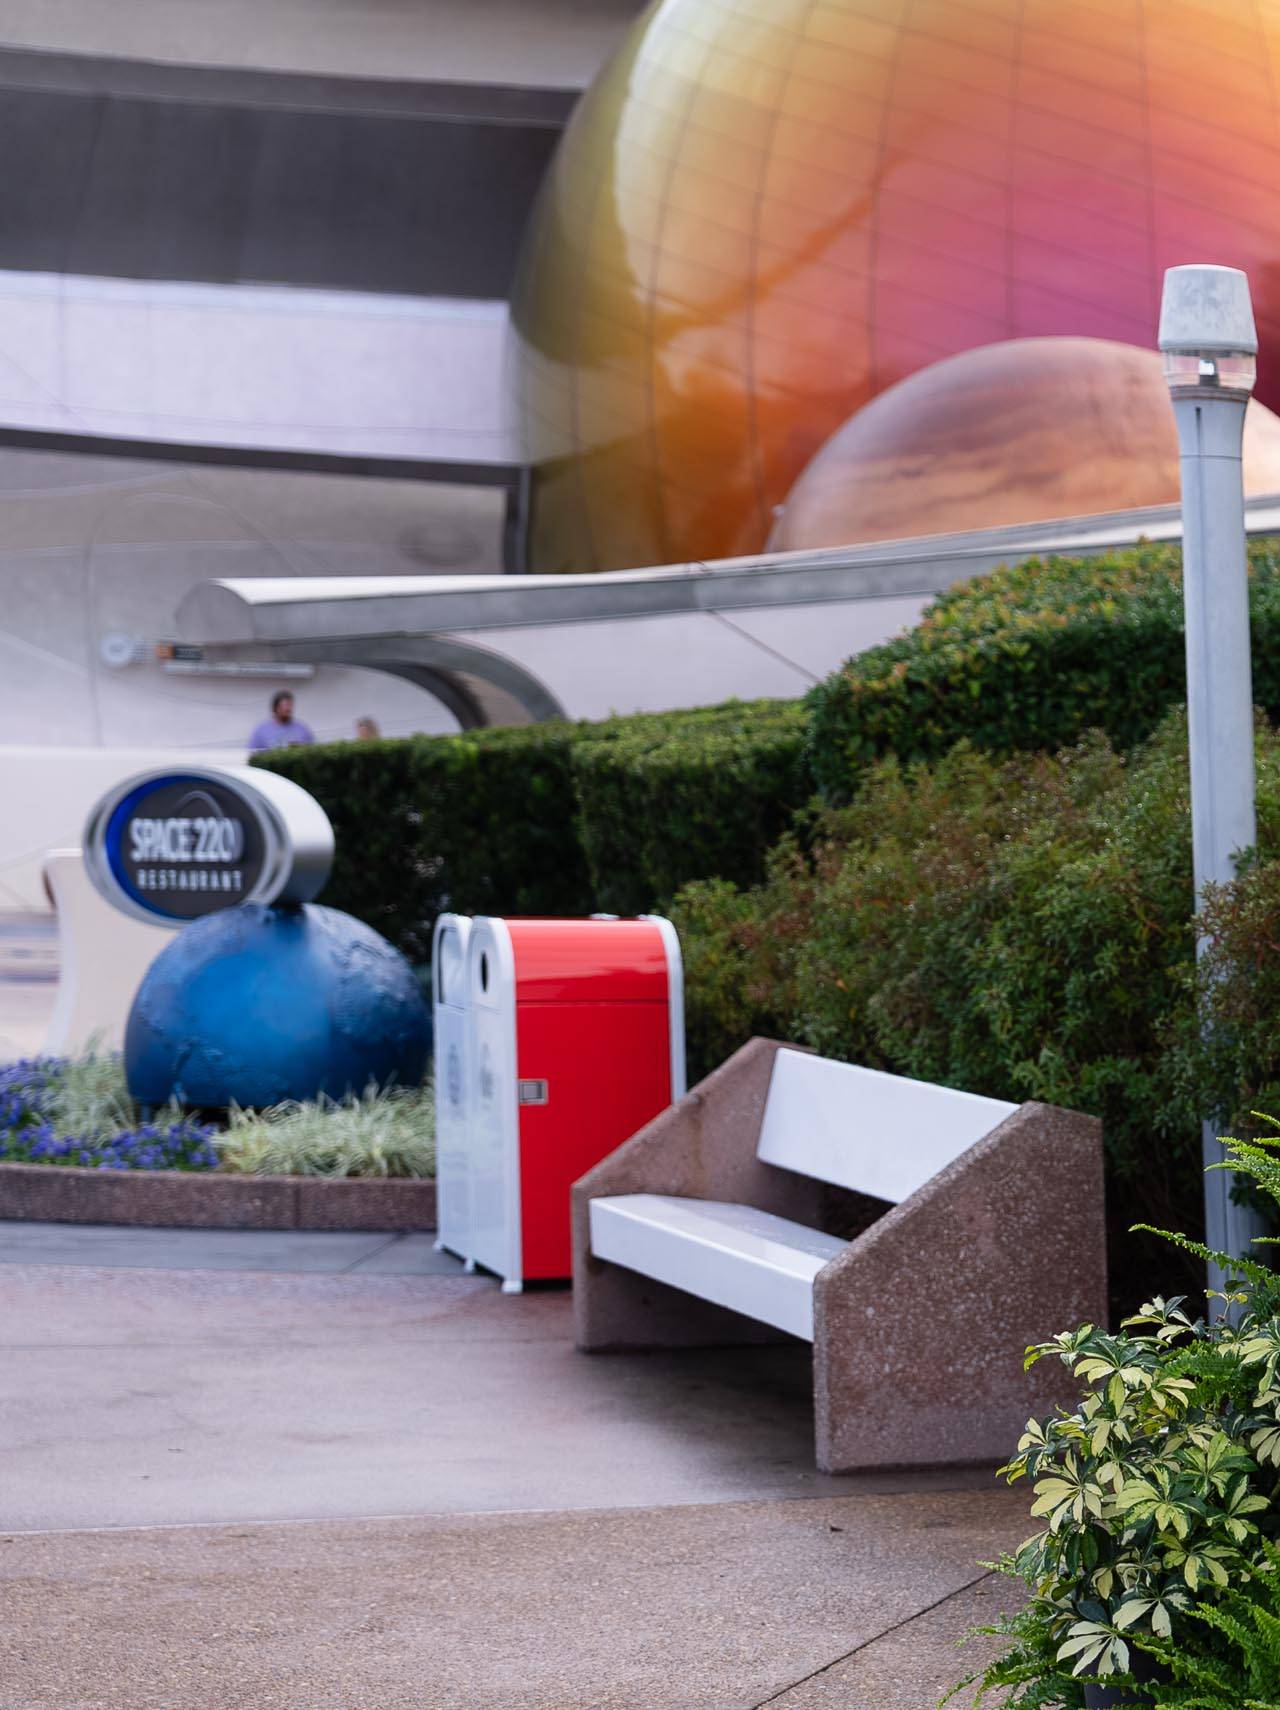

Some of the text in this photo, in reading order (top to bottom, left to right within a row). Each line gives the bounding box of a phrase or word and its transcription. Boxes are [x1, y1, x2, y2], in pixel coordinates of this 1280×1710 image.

[130, 816, 243, 862] SPACE 220
[136, 868, 242, 891] RESTAURANT
